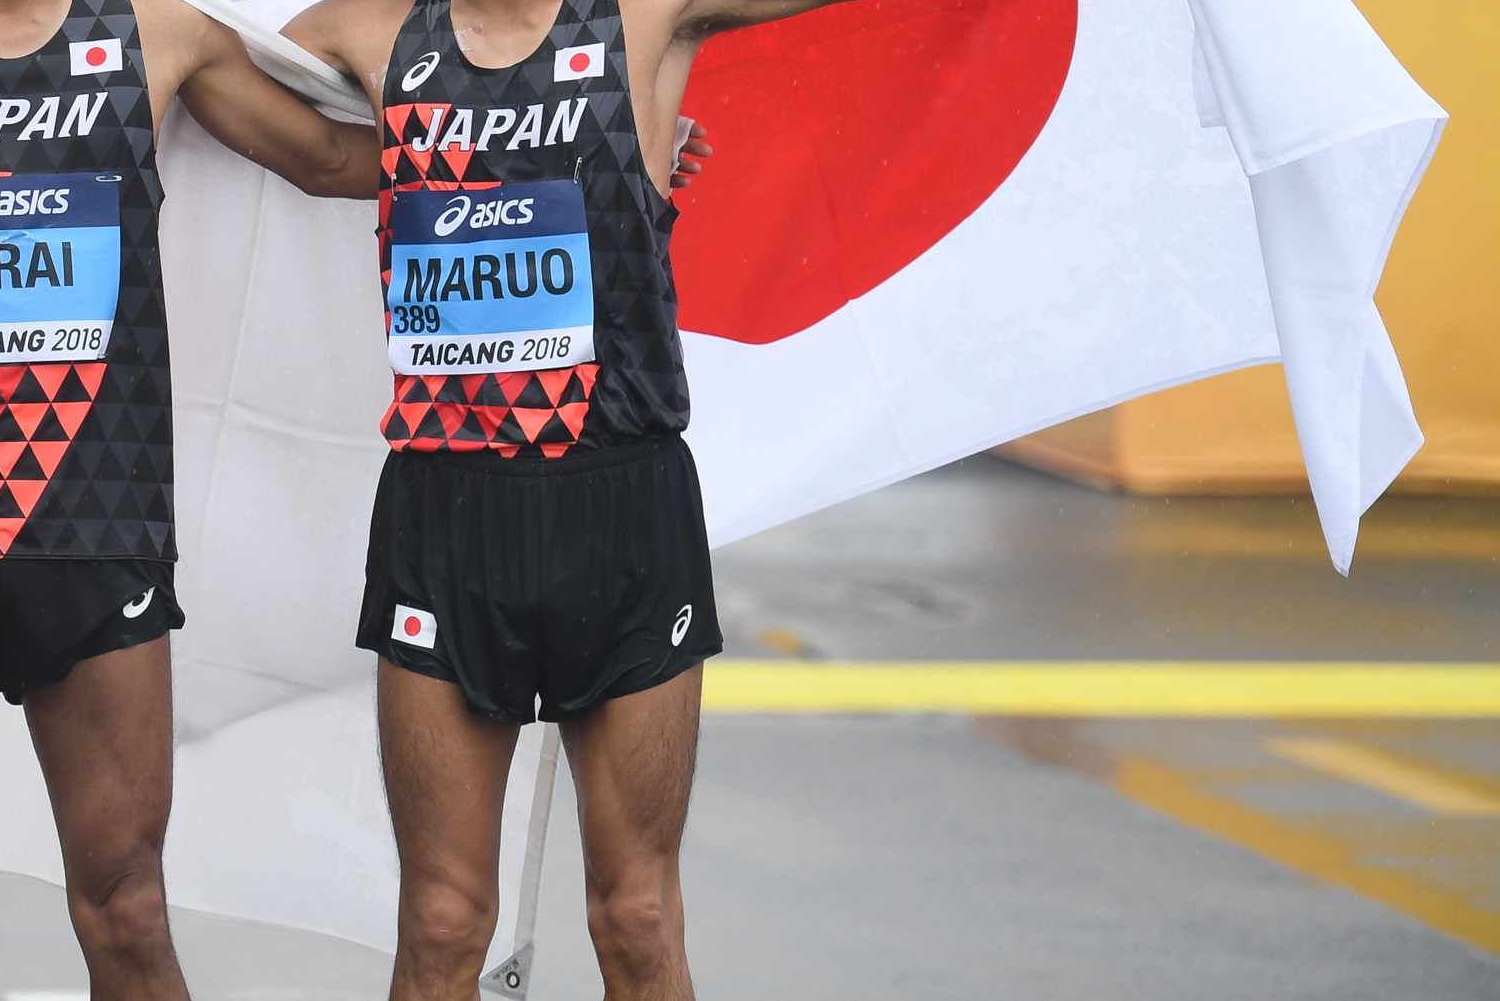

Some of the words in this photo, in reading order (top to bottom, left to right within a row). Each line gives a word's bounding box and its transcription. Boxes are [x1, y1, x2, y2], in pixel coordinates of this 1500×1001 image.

[412, 97, 588, 152] JAPAN
[469, 198, 534, 229] asics
[403, 248, 574, 303] MARUO
[394, 305, 440, 334] 389
[51, 328, 102, 352] 2018
[410, 341, 514, 366] TAICANG
[520, 336, 571, 361] 2018
